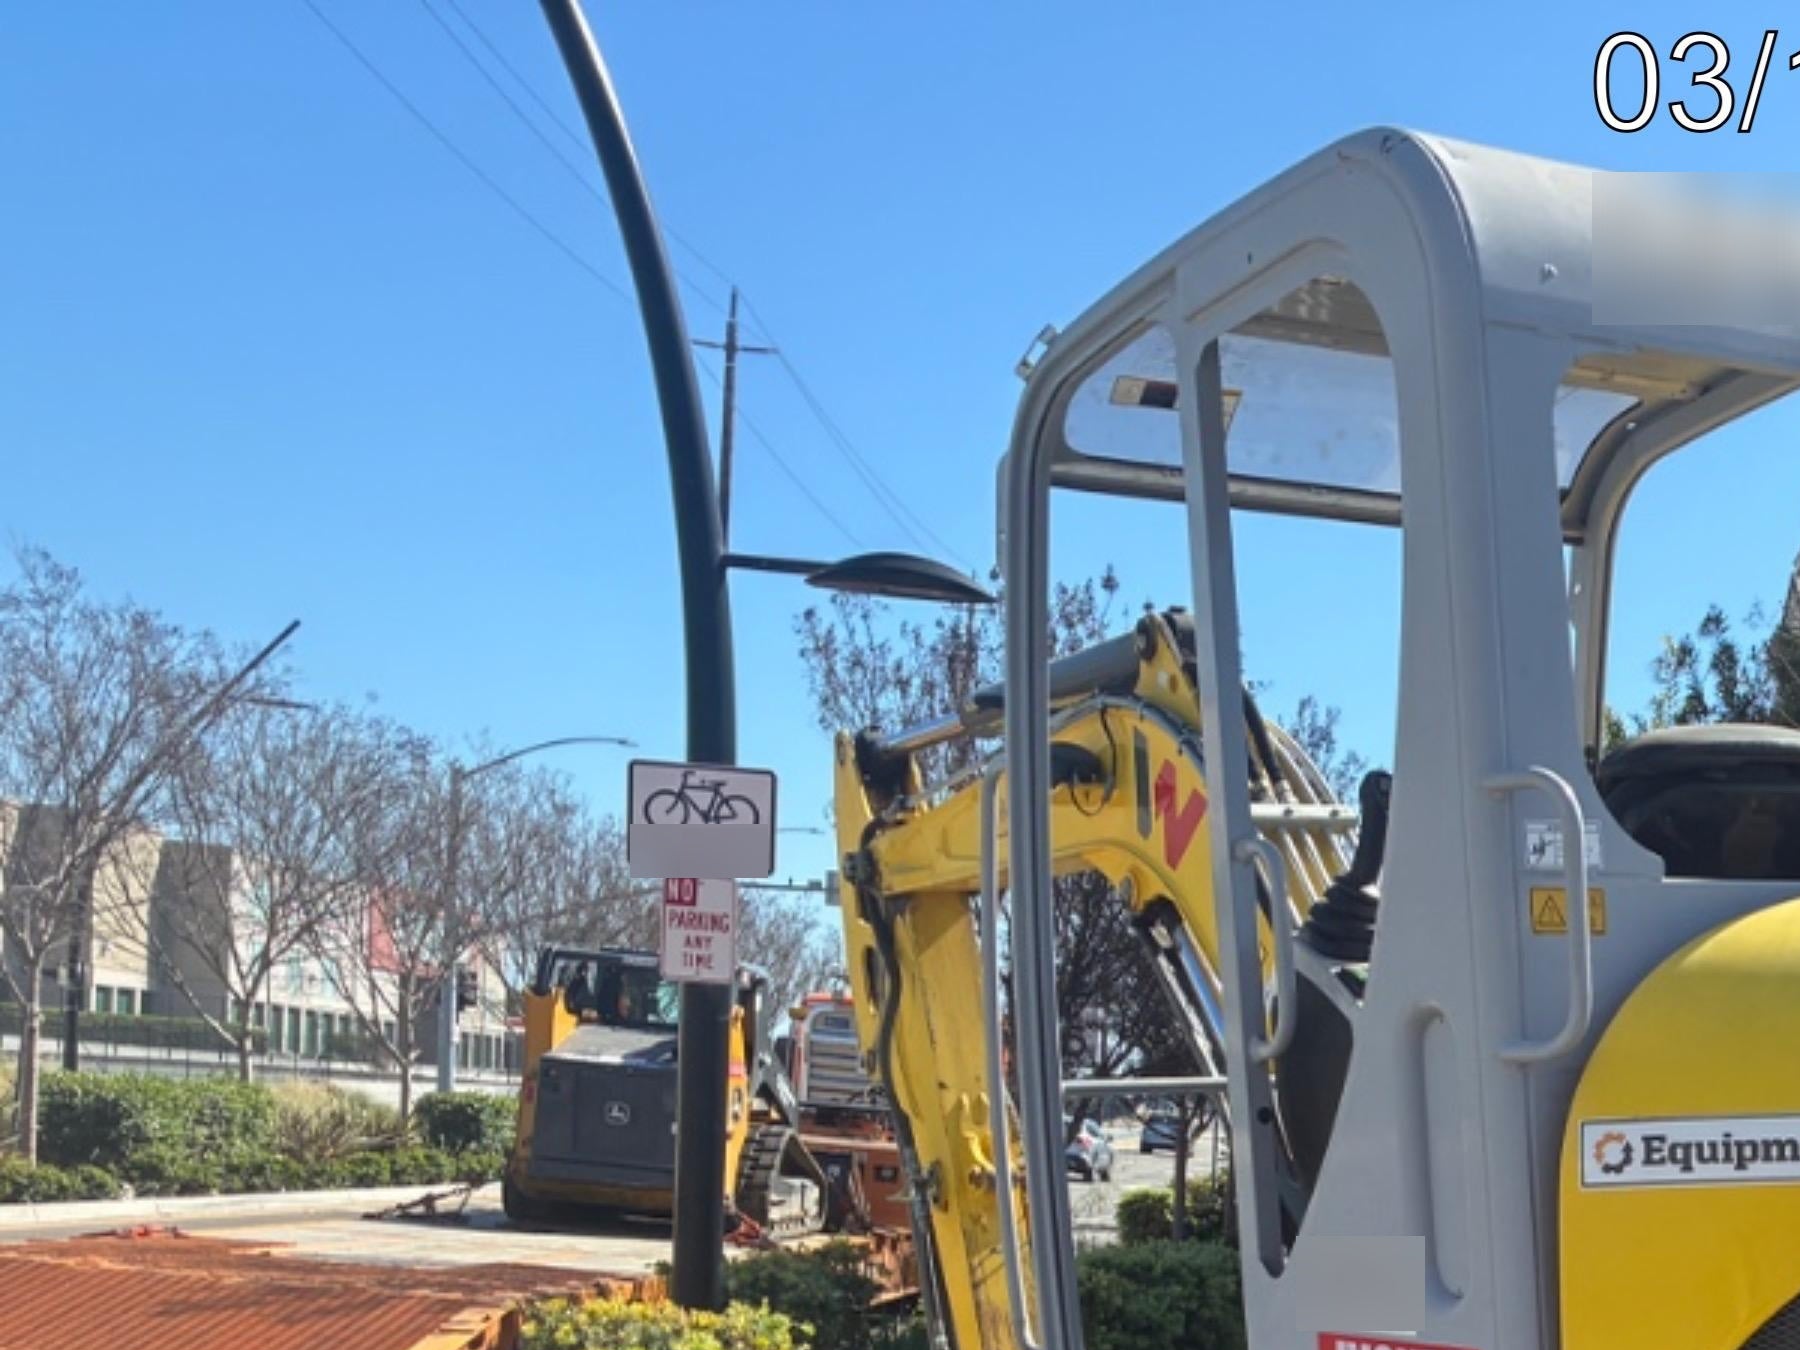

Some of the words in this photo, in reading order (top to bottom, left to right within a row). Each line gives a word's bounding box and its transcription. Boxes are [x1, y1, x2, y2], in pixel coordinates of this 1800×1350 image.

[668, 878, 694, 901] NO
[668, 909, 729, 933] PARKING
[684, 935, 713, 950] ANY
[683, 951, 714, 970] TIME
